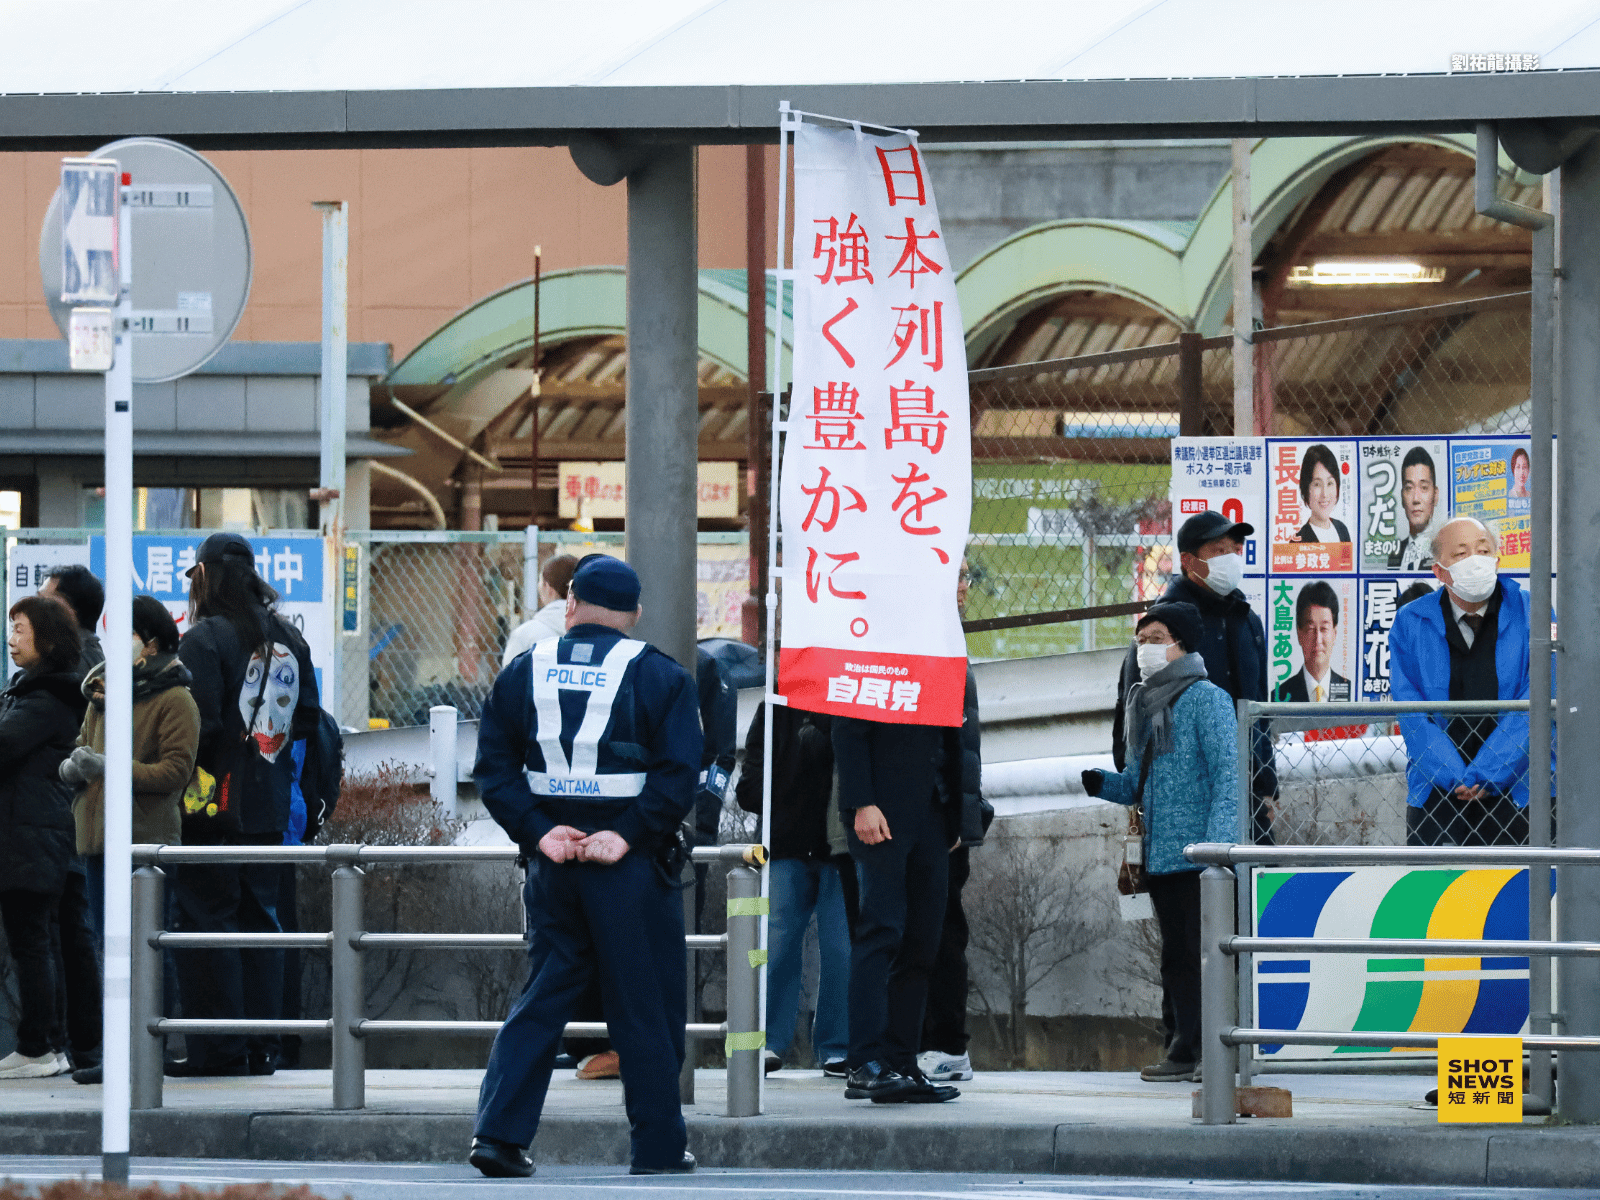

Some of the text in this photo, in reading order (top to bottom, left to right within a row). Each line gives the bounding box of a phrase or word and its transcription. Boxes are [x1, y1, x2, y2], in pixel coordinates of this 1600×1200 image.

[875, 144, 950, 565] 日本列島を、
[801, 212, 874, 638] 強く豊かに。
[1185, 462, 1252, 476] ポスター掲示場
[1274, 446, 1300, 525] 長島
[1182, 501, 1206, 512] 投票日
[1369, 462, 1396, 537] つだ
[1274, 527, 1302, 542] よしこ
[1364, 540, 1401, 555] まさのり
[1295, 553, 1330, 569] 参政党
[1273, 580, 1294, 702] 大島あつし
[546, 668, 607, 687] POLICE
[844, 662, 908, 676] 政治は国民のもの
[826, 675, 921, 712] 自民党
[549, 778, 601, 795] SAITAMA
